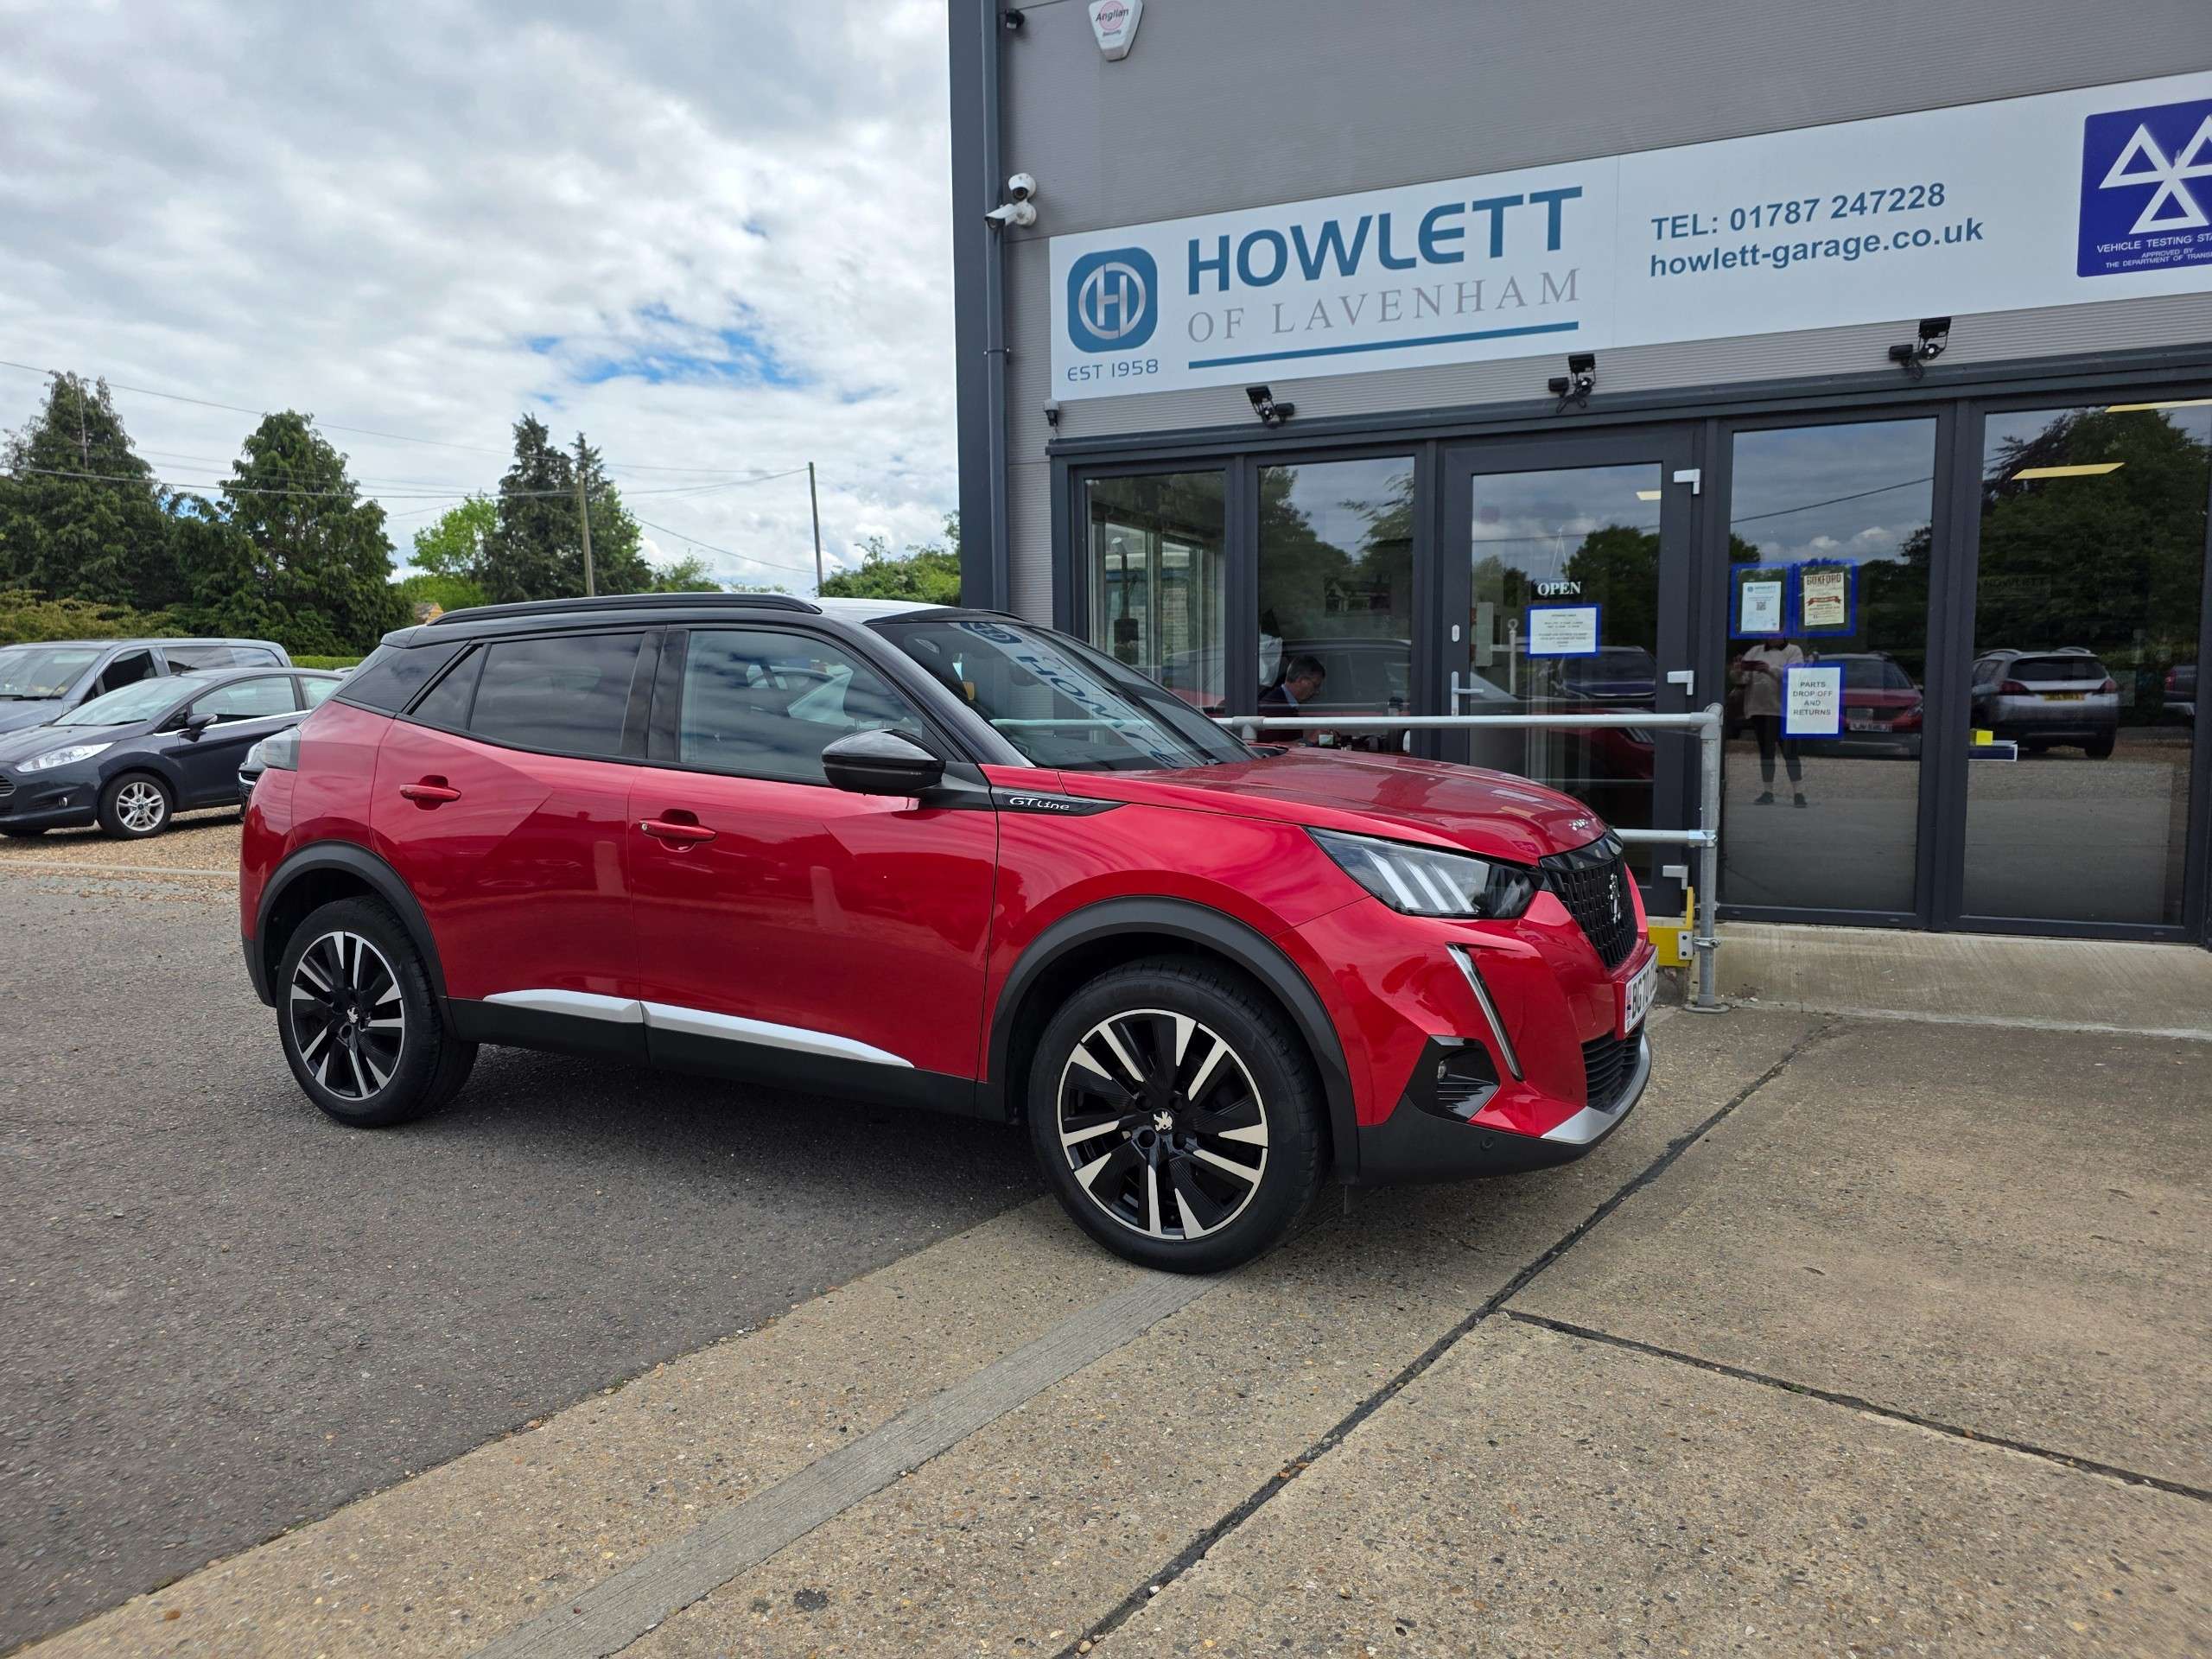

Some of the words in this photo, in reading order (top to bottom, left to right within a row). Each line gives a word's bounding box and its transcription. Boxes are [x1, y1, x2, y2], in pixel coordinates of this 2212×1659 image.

[1096, 8, 1129, 22] Anglian
[1651, 214, 1718, 240] TEL:
[1730, 198, 1820, 232] 01787
[1831, 182, 1946, 219] 247228
[1188, 186, 1583, 296] HOWLETT
[1650, 218, 1984, 277] howlett-garage.co.uk
[2097, 240, 2141, 253] VEHICLE
[2146, 235, 2192, 248] TESTING
[2123, 256, 2170, 267] DEPARTMENT
[2142, 248, 2180, 258] APPROVED
[1188, 308, 1244, 344] OF
[1272, 268, 1580, 335] LAVENHAM
[1067, 365, 1103, 382] EST
[1112, 359, 1158, 378] 1958
[1537, 582, 1581, 596] OPEN
